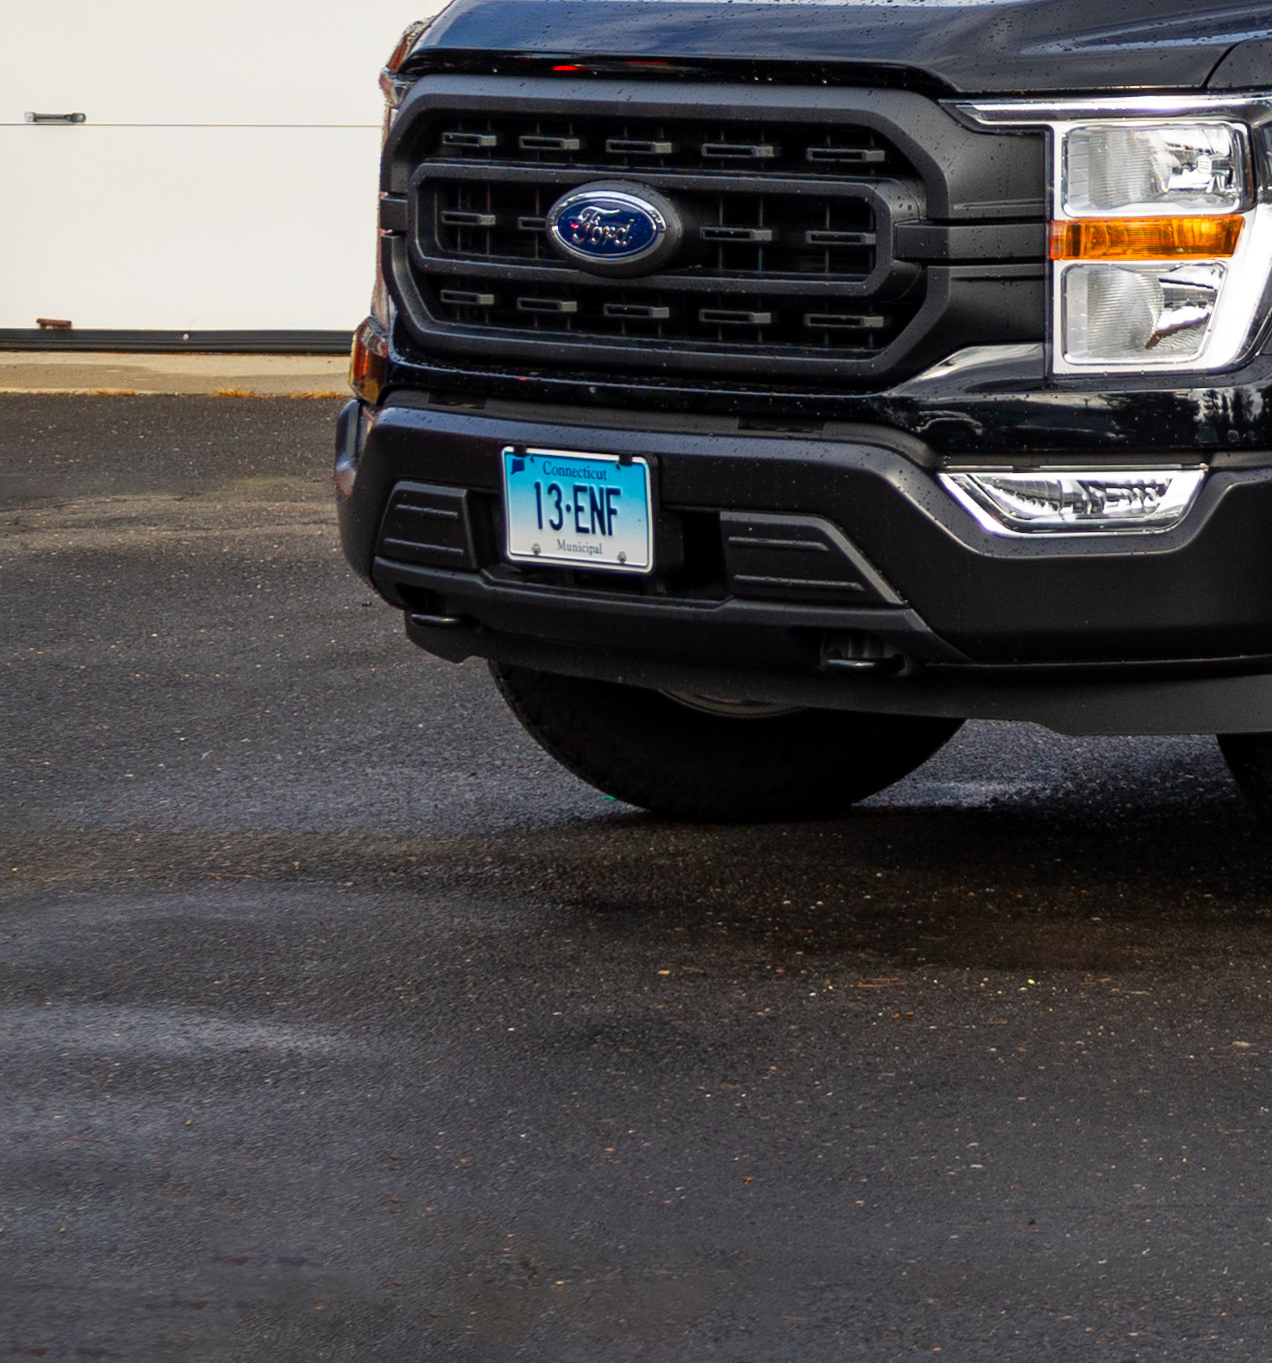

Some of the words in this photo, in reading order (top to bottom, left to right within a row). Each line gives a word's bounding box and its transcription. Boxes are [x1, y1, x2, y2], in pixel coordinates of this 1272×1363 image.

[570, 205, 635, 246] Ford
[542, 459, 608, 481] Connecticut
[556, 538, 603, 555] Municipal
